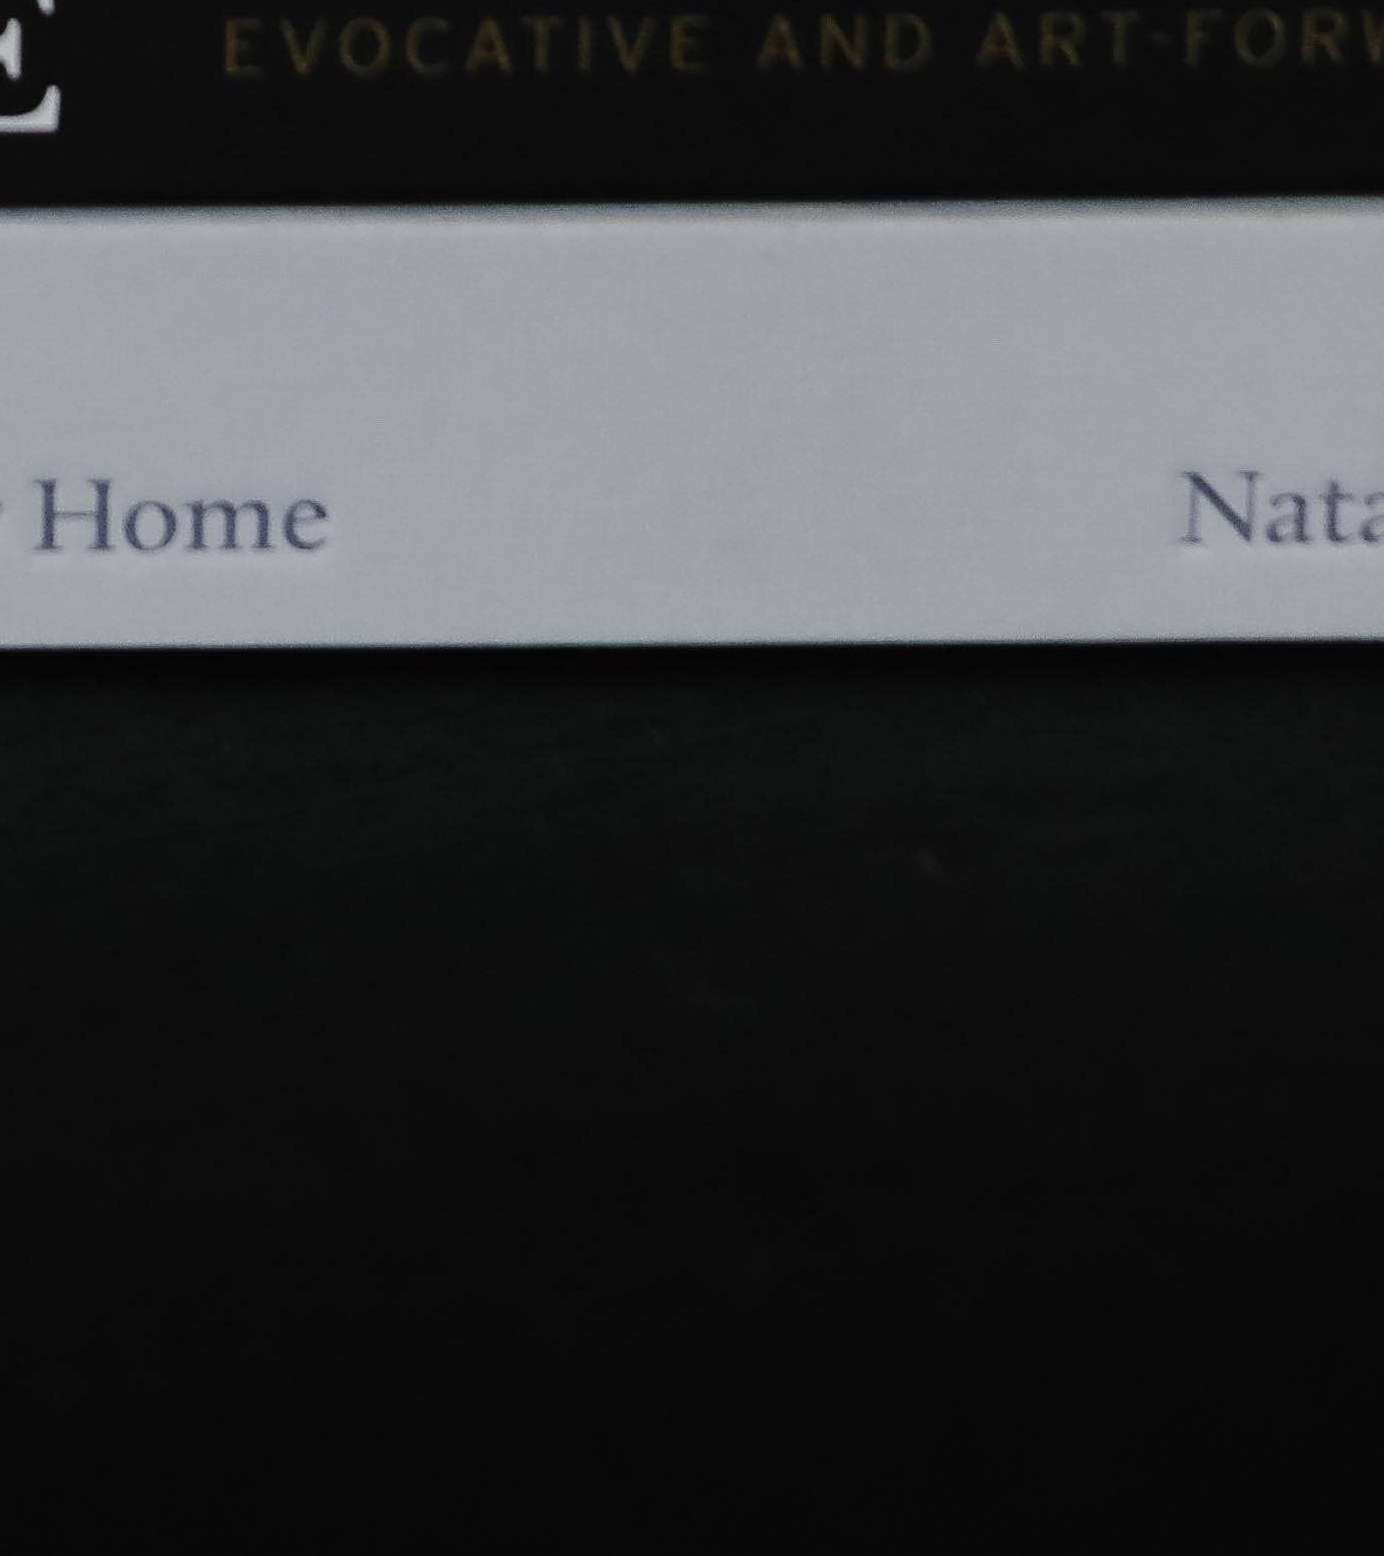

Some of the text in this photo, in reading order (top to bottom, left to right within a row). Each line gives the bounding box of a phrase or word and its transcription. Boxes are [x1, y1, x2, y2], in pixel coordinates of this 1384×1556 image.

[224, 15, 704, 77] EVOCATIVE
[758, 14, 930, 70] AND
[35, 479, 328, 551] Home
